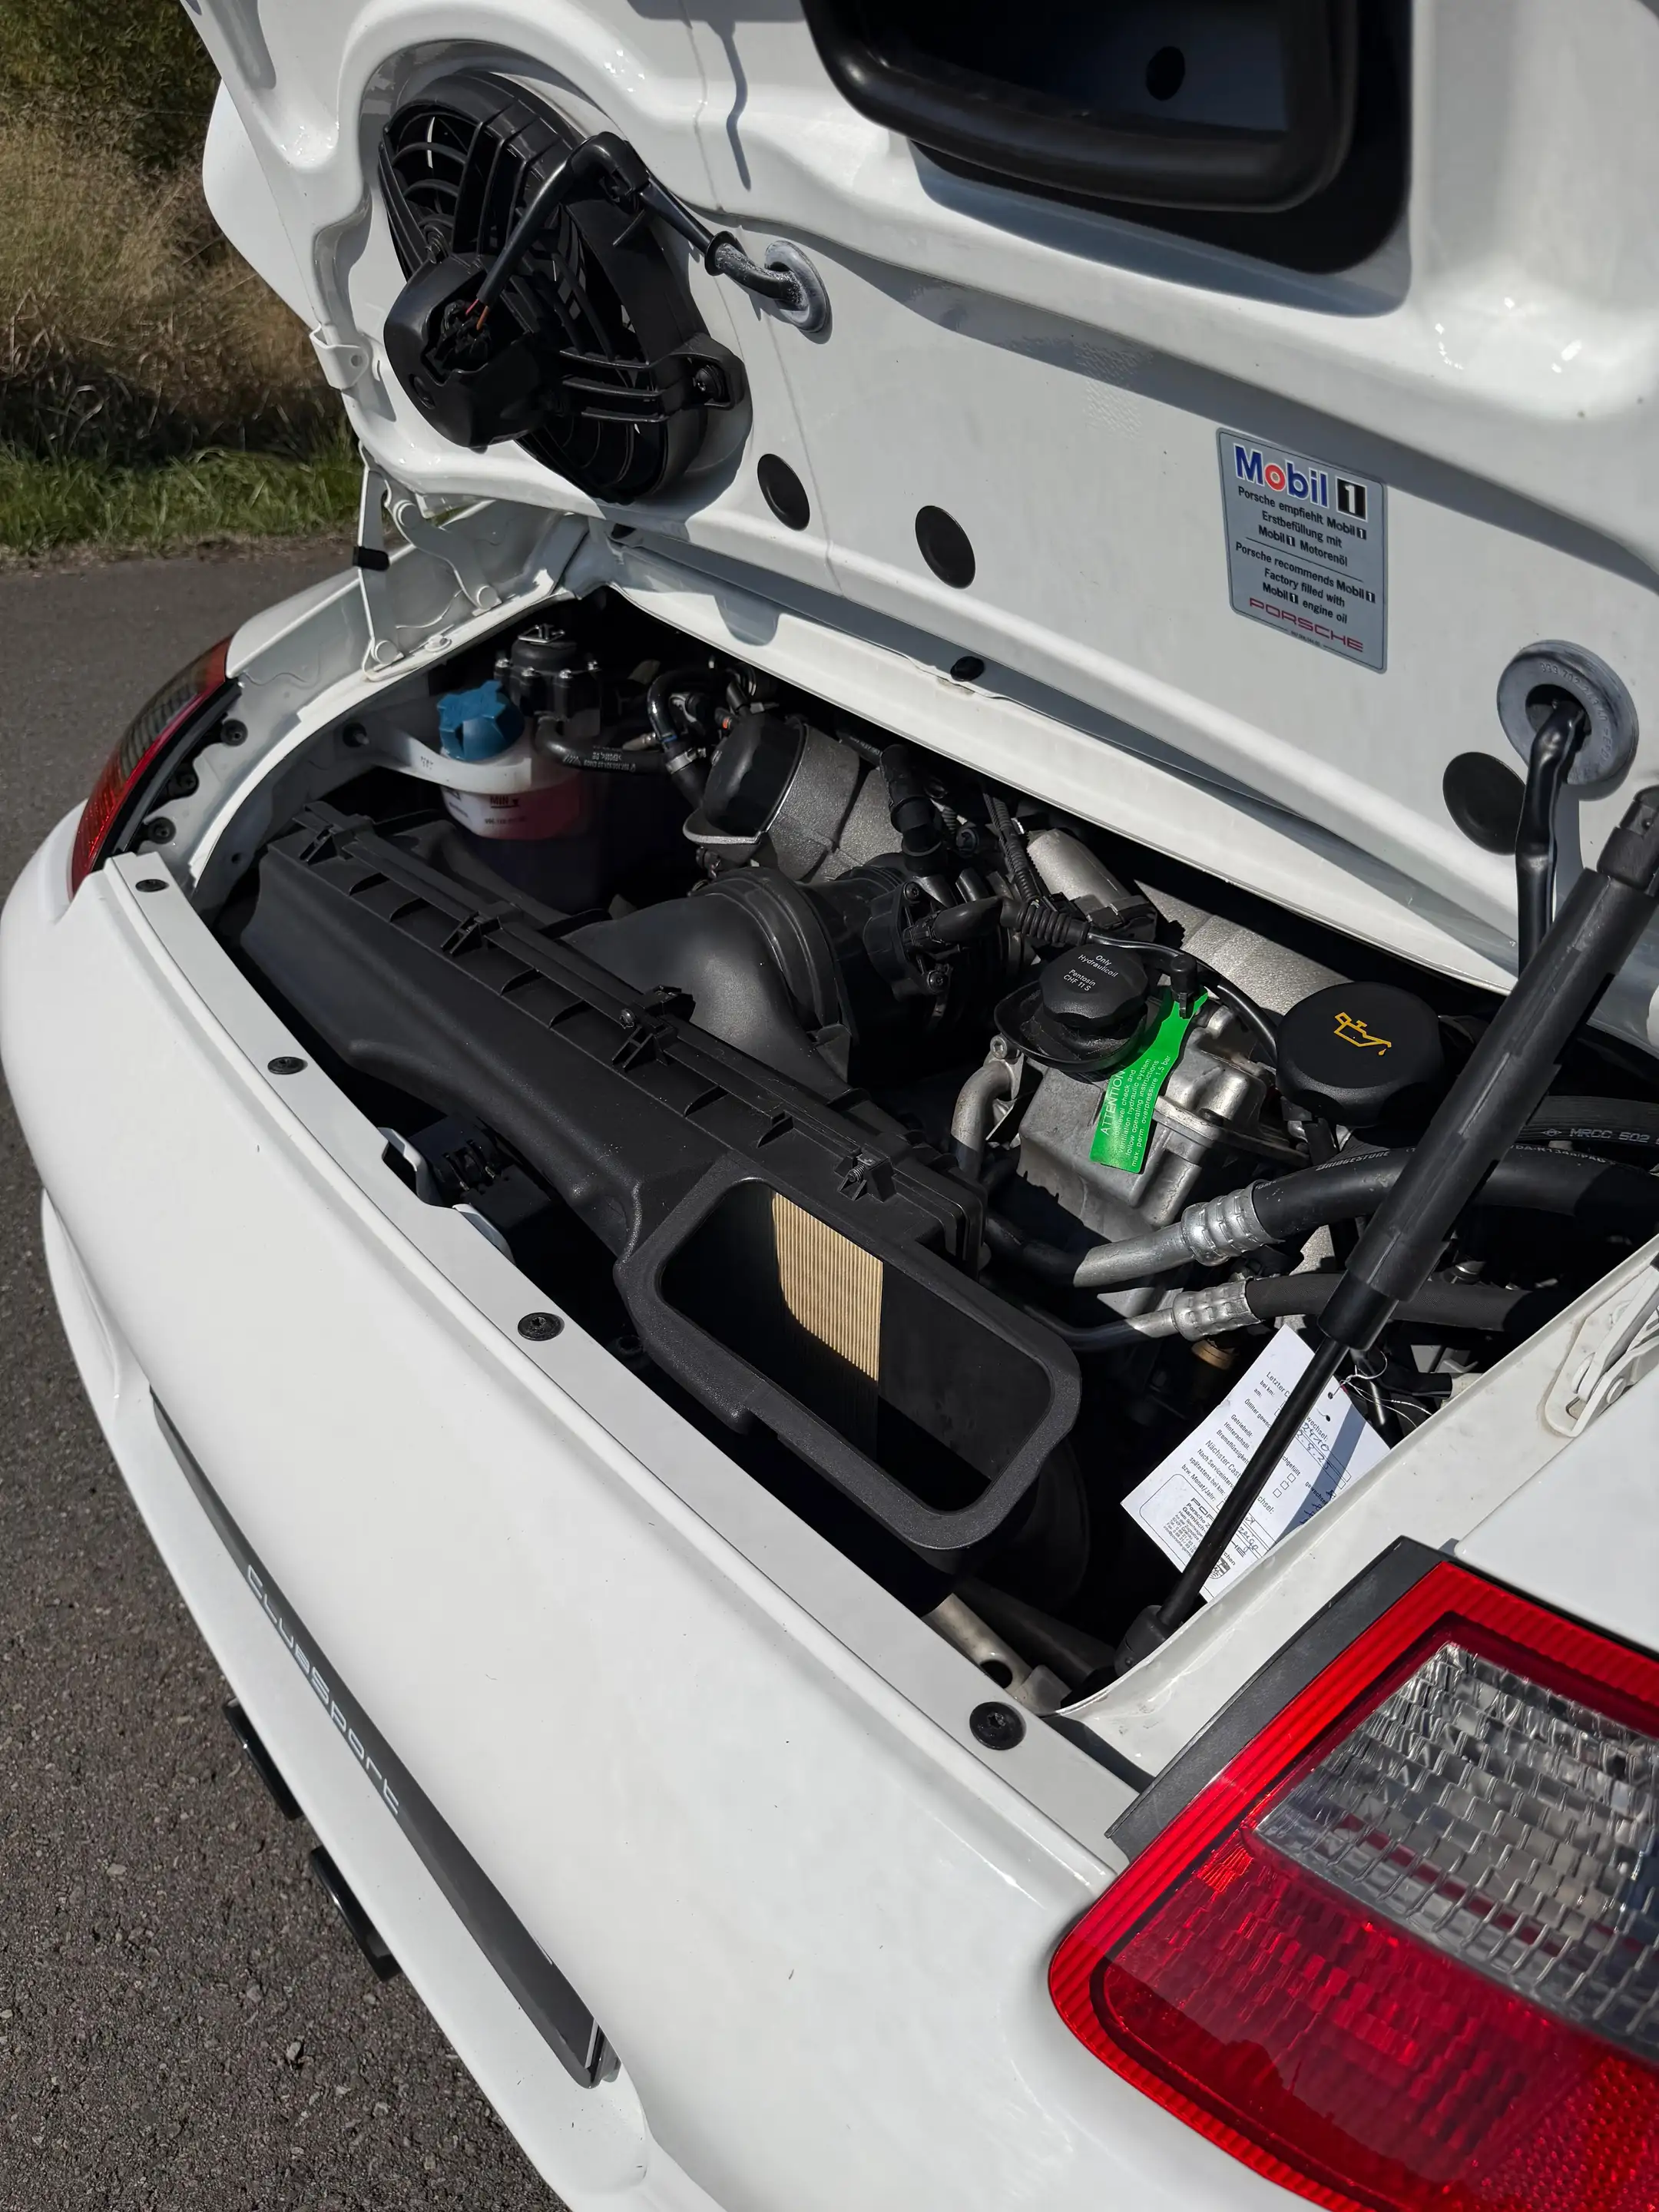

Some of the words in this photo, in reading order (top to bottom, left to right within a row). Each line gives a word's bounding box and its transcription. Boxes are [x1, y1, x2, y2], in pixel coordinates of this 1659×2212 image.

[1233, 443, 1330, 508] Mobil
[1238, 486, 1275, 507] Porsche
[1279, 502, 1323, 525] empfiehlt
[1327, 517, 1355, 535] Mobil
[1259, 525, 1284, 543] Mobil
[1300, 540, 1347, 566] Motorenöl
[1262, 511, 1323, 542] Erstbefüllung
[1326, 536, 1342, 548] mit
[1236, 541, 1271, 562] Porsche
[1274, 558, 1334, 587] recommends
[1336, 580, 1364, 599] Mobil
[1265, 568, 1299, 590] Factory
[1301, 584, 1323, 598] filled
[1326, 594, 1345, 607] with
[1263, 582, 1288, 600] Mobil
[1303, 600, 1333, 618] engine
[1336, 613, 1347, 624] oil
[1250, 598, 1363, 652] PORSCHE
[1063, 974, 1078, 983] CHF
[1069, 969, 1096, 986] Pentosin
[1078, 955, 1118, 977] Hydraulicoil
[1096, 955, 1111, 966] Only
[1118, 1117, 1131, 1153] ventilation
[1127, 1081, 1139, 1114] hydraulic
[1136, 1058, 1151, 1080] system
[1121, 1084, 1130, 1105] check
[1127, 1069, 1136, 1081] and
[1136, 1126, 1144, 1147] perm.
[1141, 1078, 1157, 1124] overpressure
[1161, 1055, 1171, 1065] bar
[1124, 1134, 1134, 1155] follow
[1131, 1099, 1144, 1133] operating
[1138, 1059, 1159, 1096] instructions
[1243, 1398, 1258, 1414] Ölfilter
[1253, 1388, 1262, 1398] am:
[1259, 1379, 1268, 1389] bei
[1266, 1386, 1275, 1396] km:
[1265, 1371, 1285, 1392] Letzter
[1306, 1416, 1329, 1442] wechsel:
[1224, 1422, 1250, 1450] Hinterachsöl:
[1230, 1413, 1253, 1438] Getriebeöl:
[1197, 1449, 1209, 1462] Nach
[1207, 1459, 1234, 1488] Serviceinterv
[1205, 1439, 1230, 1466] Nächster
[1281, 1455, 1301, 1476] chgefüllt
[1181, 1463, 1192, 1475] bzw.
[1190, 1473, 1216, 1501] Monat/Jahr:
[1188, 1456, 1211, 1480] spätestens
[1210, 1478, 1218, 1487] bei
[1217, 1485, 1225, 1495] km:
[1186, 1502, 1207, 1524] Porsche
